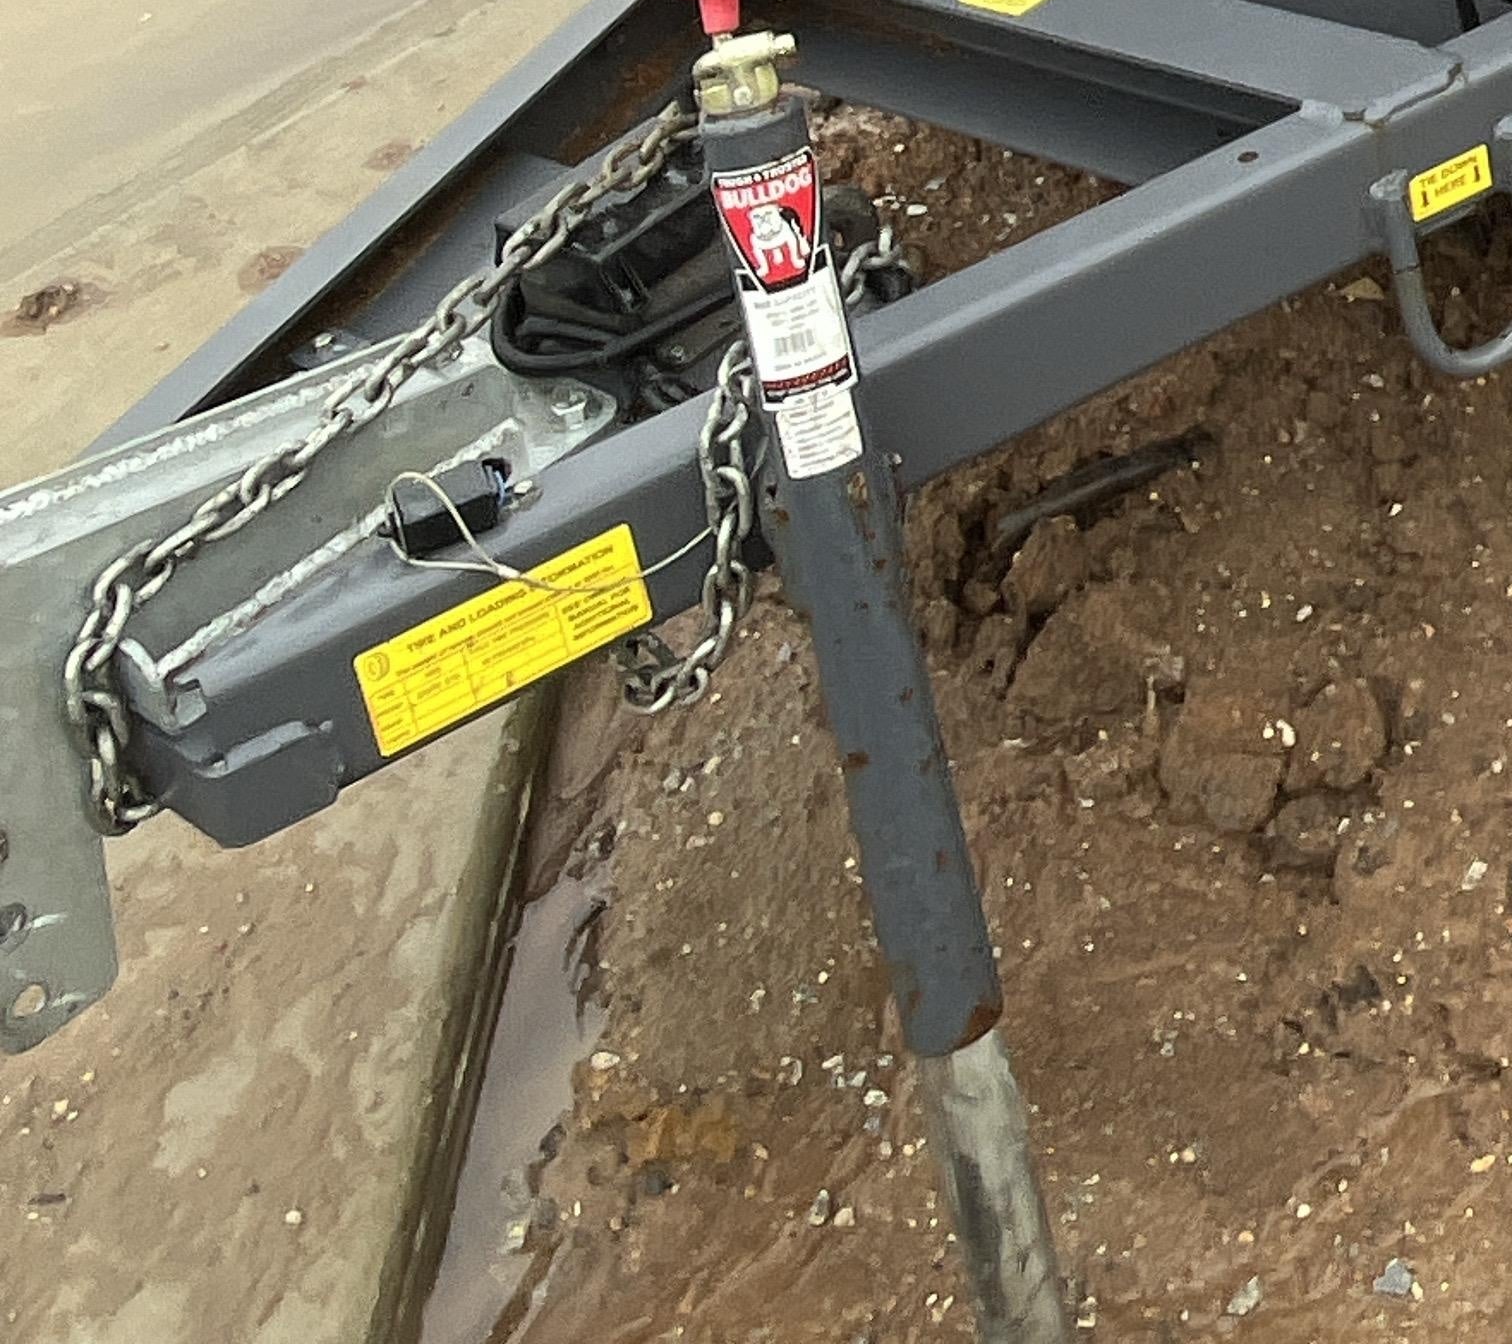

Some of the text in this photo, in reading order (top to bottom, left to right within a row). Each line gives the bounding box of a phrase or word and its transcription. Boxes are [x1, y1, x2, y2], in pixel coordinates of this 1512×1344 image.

[720, 166, 813, 209] BULLDOG
[439, 618, 466, 638] AND
[469, 588, 528, 623] LOADING
[530, 544, 615, 594] IFORMATION
